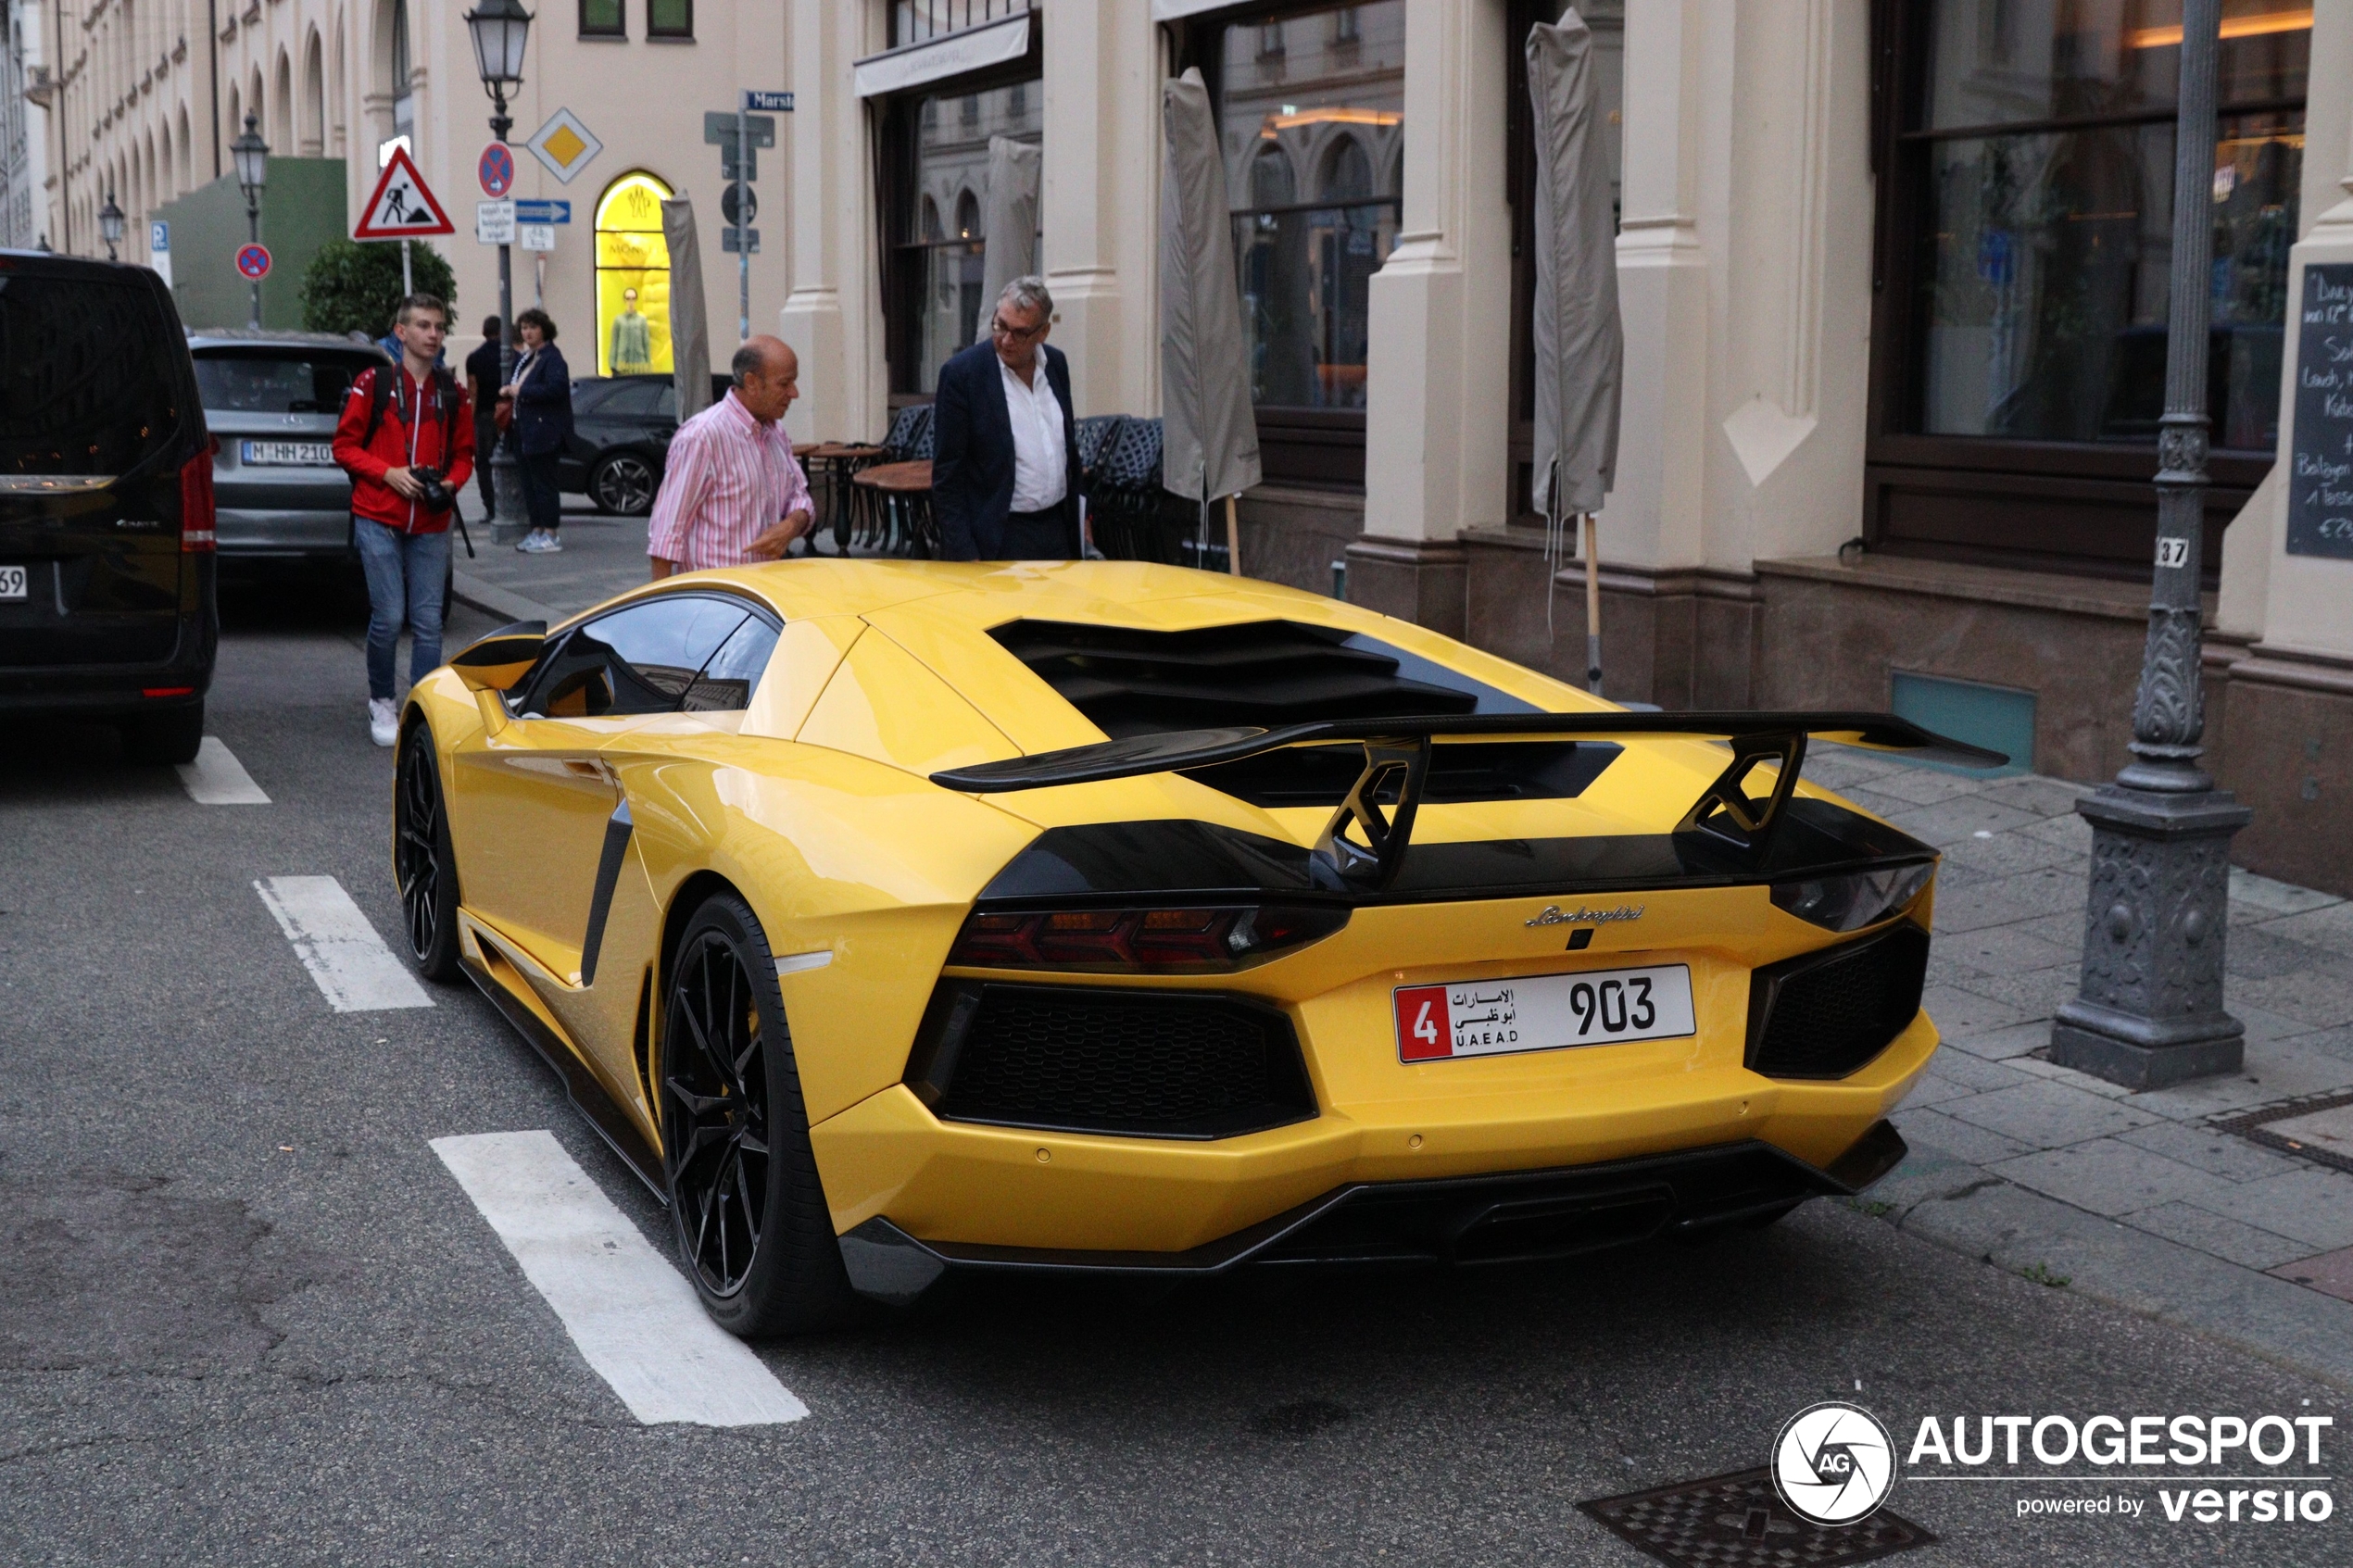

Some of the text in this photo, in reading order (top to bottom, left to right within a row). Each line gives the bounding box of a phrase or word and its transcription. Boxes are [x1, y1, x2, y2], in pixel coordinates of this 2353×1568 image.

[254, 445, 336, 460] M HH 210
[2162, 543, 2185, 562] 37
[1525, 904, 1645, 927] Lamborghini
[1570, 977, 1655, 1035] 903
[1414, 1000, 1438, 1045] 4
